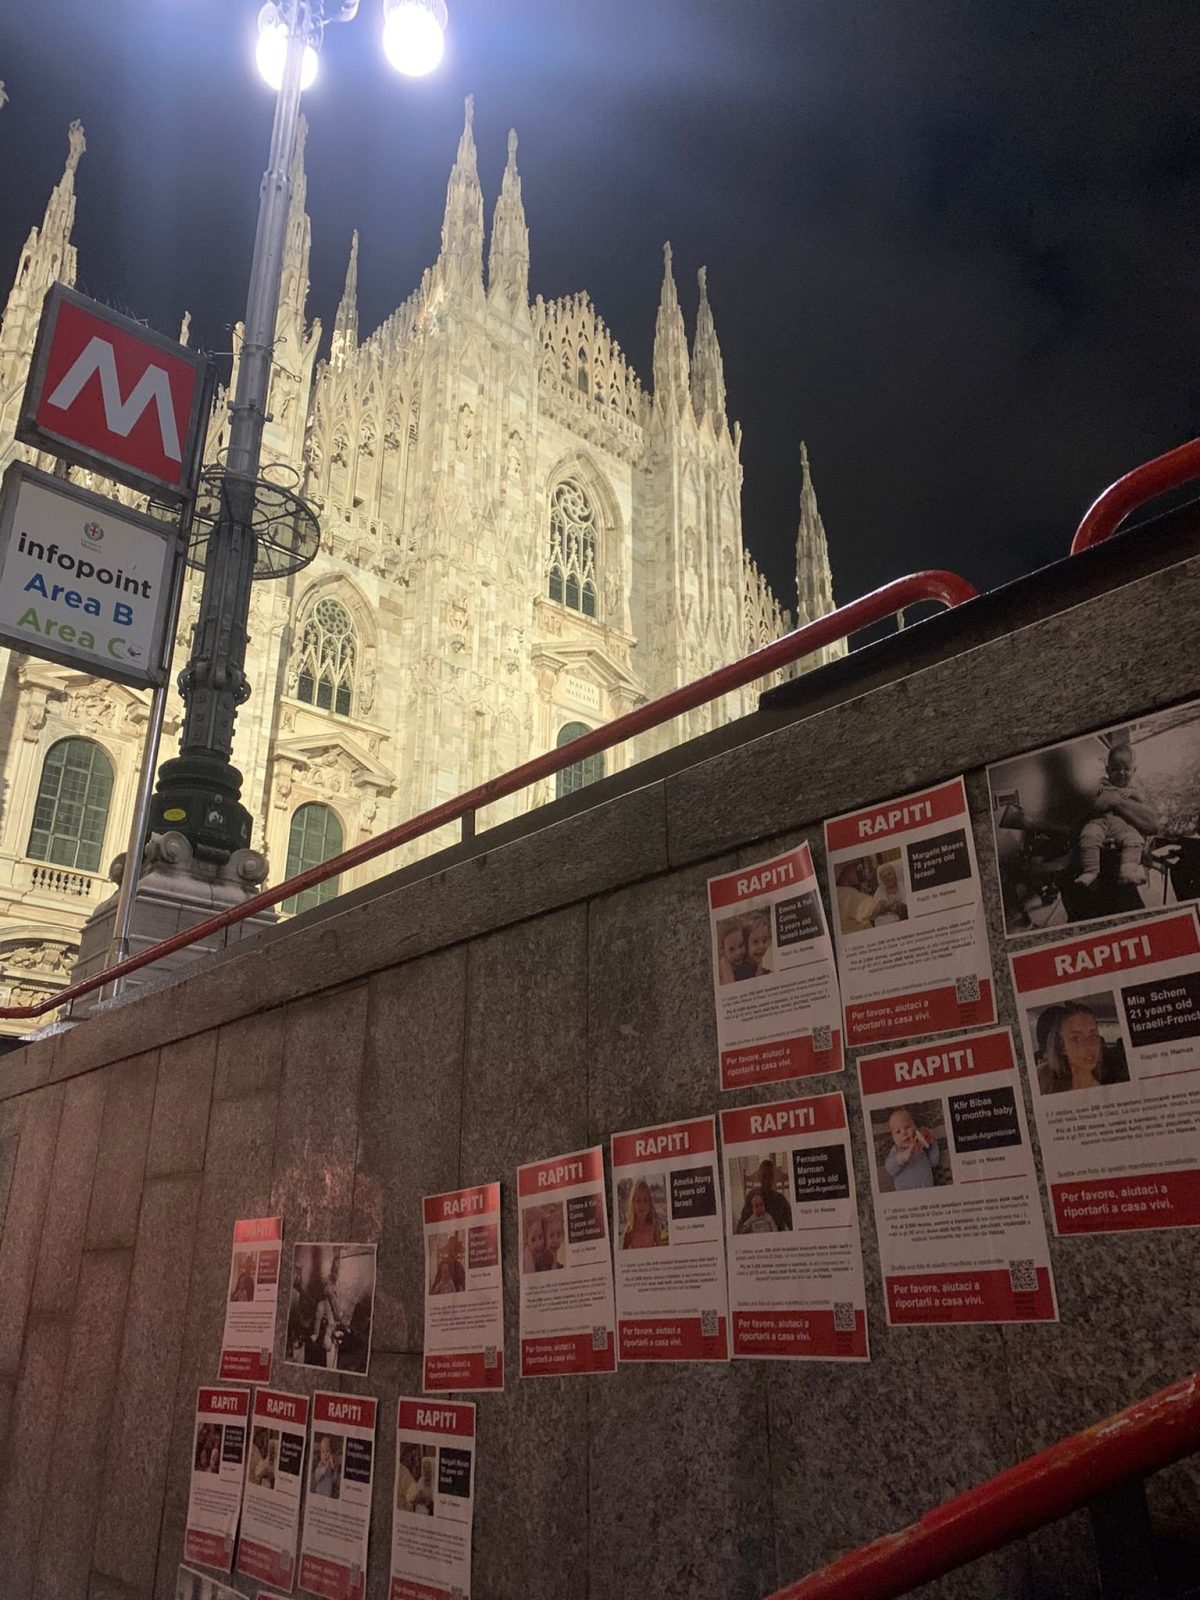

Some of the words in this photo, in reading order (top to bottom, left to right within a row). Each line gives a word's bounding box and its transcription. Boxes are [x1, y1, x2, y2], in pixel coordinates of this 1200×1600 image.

[47, 336, 182, 462] M
[18, 532, 151, 599] infopoint
[24, 573, 100, 616] Area
[113, 602, 133, 626] B
[17, 607, 95, 649] Area
[108, 637, 126, 660] C
[858, 800, 933, 837] RAPITI
[922, 857, 942, 869] years
[943, 852, 955, 862] old
[736, 862, 795, 896] RAPITI
[914, 868, 935, 879] Israeli
[780, 929, 798, 940] Israeli
[799, 925, 818, 935] babies
[784, 920, 801, 933] years
[801, 916, 811, 925] old
[1054, 935, 1152, 977] RAPITI
[1127, 995, 1145, 1006] Mia
[1150, 987, 1187, 1002] Schem
[851, 1010, 865, 1020] Per
[866, 1006, 894, 1018] favore,
[895, 1000, 922, 1012] aiutaci
[1129, 1008, 1142, 1019] 21
[1143, 1003, 1173, 1018] years
[1175, 998, 1193, 1010] old
[852, 1017, 886, 1032] riportarli
[887, 1018, 893, 1026] a
[894, 1014, 913, 1025] casa
[914, 1011, 932, 1022] vivi.
[726, 1057, 738, 1066] Per
[739, 1053, 762, 1063] favore,
[762, 1048, 785, 1058] aiutaci
[894, 1048, 975, 1082] RAPITI
[727, 1064, 755, 1077] riportarli
[760, 1061, 777, 1069] casa
[779, 1058, 791, 1066] vivi.
[953, 1101, 968, 1111] Kfir
[969, 1098, 992, 1108] Bibas
[955, 1113, 960, 1122] 9
[962, 1109, 992, 1120] months
[993, 1105, 1013, 1117] baby
[750, 1107, 815, 1134] RAPITI
[635, 1131, 690, 1157] RAPITI
[796, 1153, 828, 1164] Fernando
[537, 1161, 583, 1187] RAPITI
[797, 1166, 824, 1175] Marman
[807, 1176, 826, 1186] years
[827, 1174, 839, 1182] old
[679, 1189, 695, 1198] years
[696, 1186, 706, 1194] old
[1061, 1192, 1079, 1203] Per
[1081, 1189, 1118, 1200] favore,
[1120, 1183, 1158, 1196] aiutaci
[1160, 1185, 1168, 1194] a
[443, 1194, 483, 1216] RAPITI
[674, 1200, 693, 1208] Israeli
[1063, 1204, 1109, 1219] riportarli
[1111, 1205, 1118, 1214] a
[1120, 1201, 1147, 1212] casa
[1150, 1197, 1174, 1210] vivi.
[893, 1284, 908, 1294] Per
[910, 1283, 940, 1293] favore,
[942, 1280, 971, 1292] aiutaci
[974, 1282, 980, 1290] a
[895, 1297, 933, 1309] riportarli
[934, 1299, 940, 1307] a
[942, 1297, 963, 1306] casa
[964, 1295, 984, 1305] vivi.
[623, 1327, 633, 1335] Per
[634, 1327, 655, 1335] favore,
[656, 1326, 677, 1334] aiutaci
[738, 1319, 750, 1328] Per
[752, 1319, 777, 1329] favore,
[778, 1319, 803, 1328] aiutaci
[623, 1339, 649, 1348] riportarli
[739, 1332, 770, 1342] riportarli
[796, 1332, 812, 1340] vivi.
[211, 1395, 238, 1410] RAPITI
[266, 1398, 296, 1417] RAPITI
[328, 1402, 361, 1421] RAPITI
[416, 1409, 457, 1429] RAPITI
